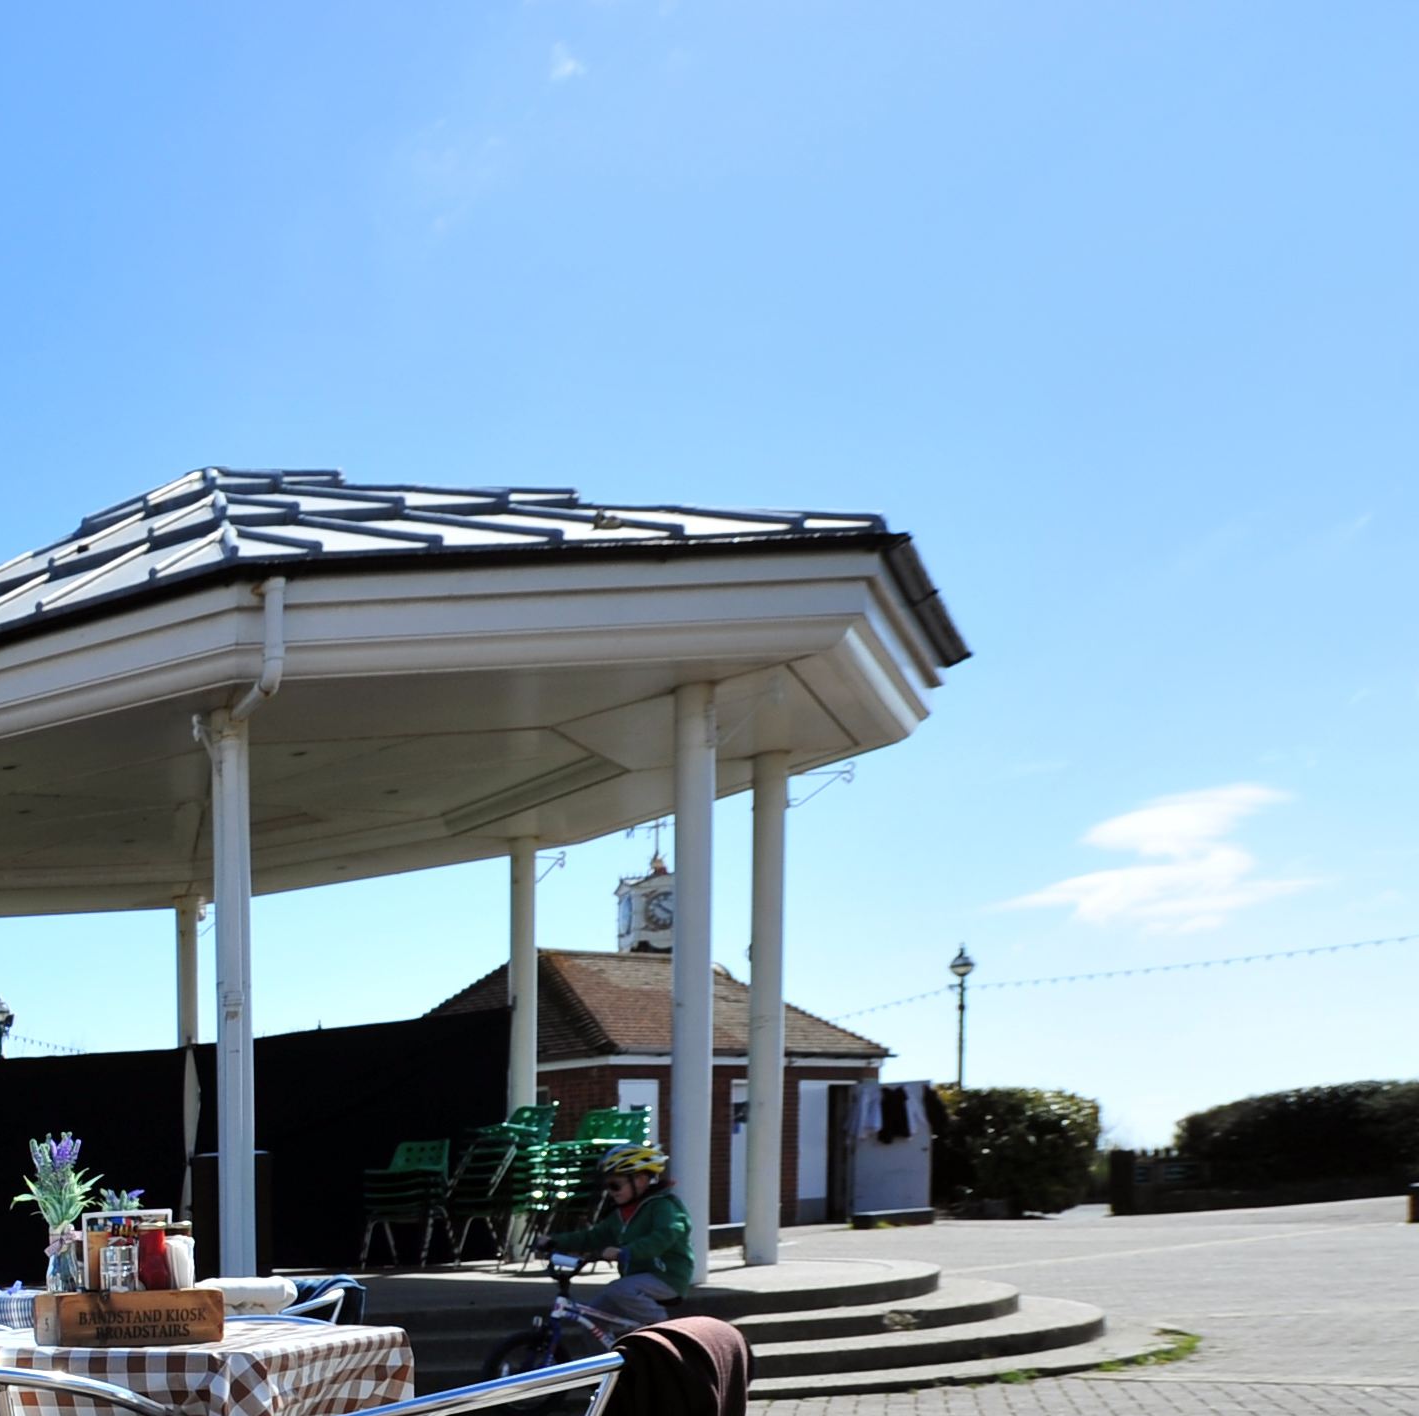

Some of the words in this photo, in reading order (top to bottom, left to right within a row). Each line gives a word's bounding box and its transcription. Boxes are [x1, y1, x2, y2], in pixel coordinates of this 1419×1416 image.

[78, 1309, 161, 1326] BANDSTAND
[165, 1307, 207, 1323] KIOSK
[95, 1323, 191, 1341] BROADSTAIRS
